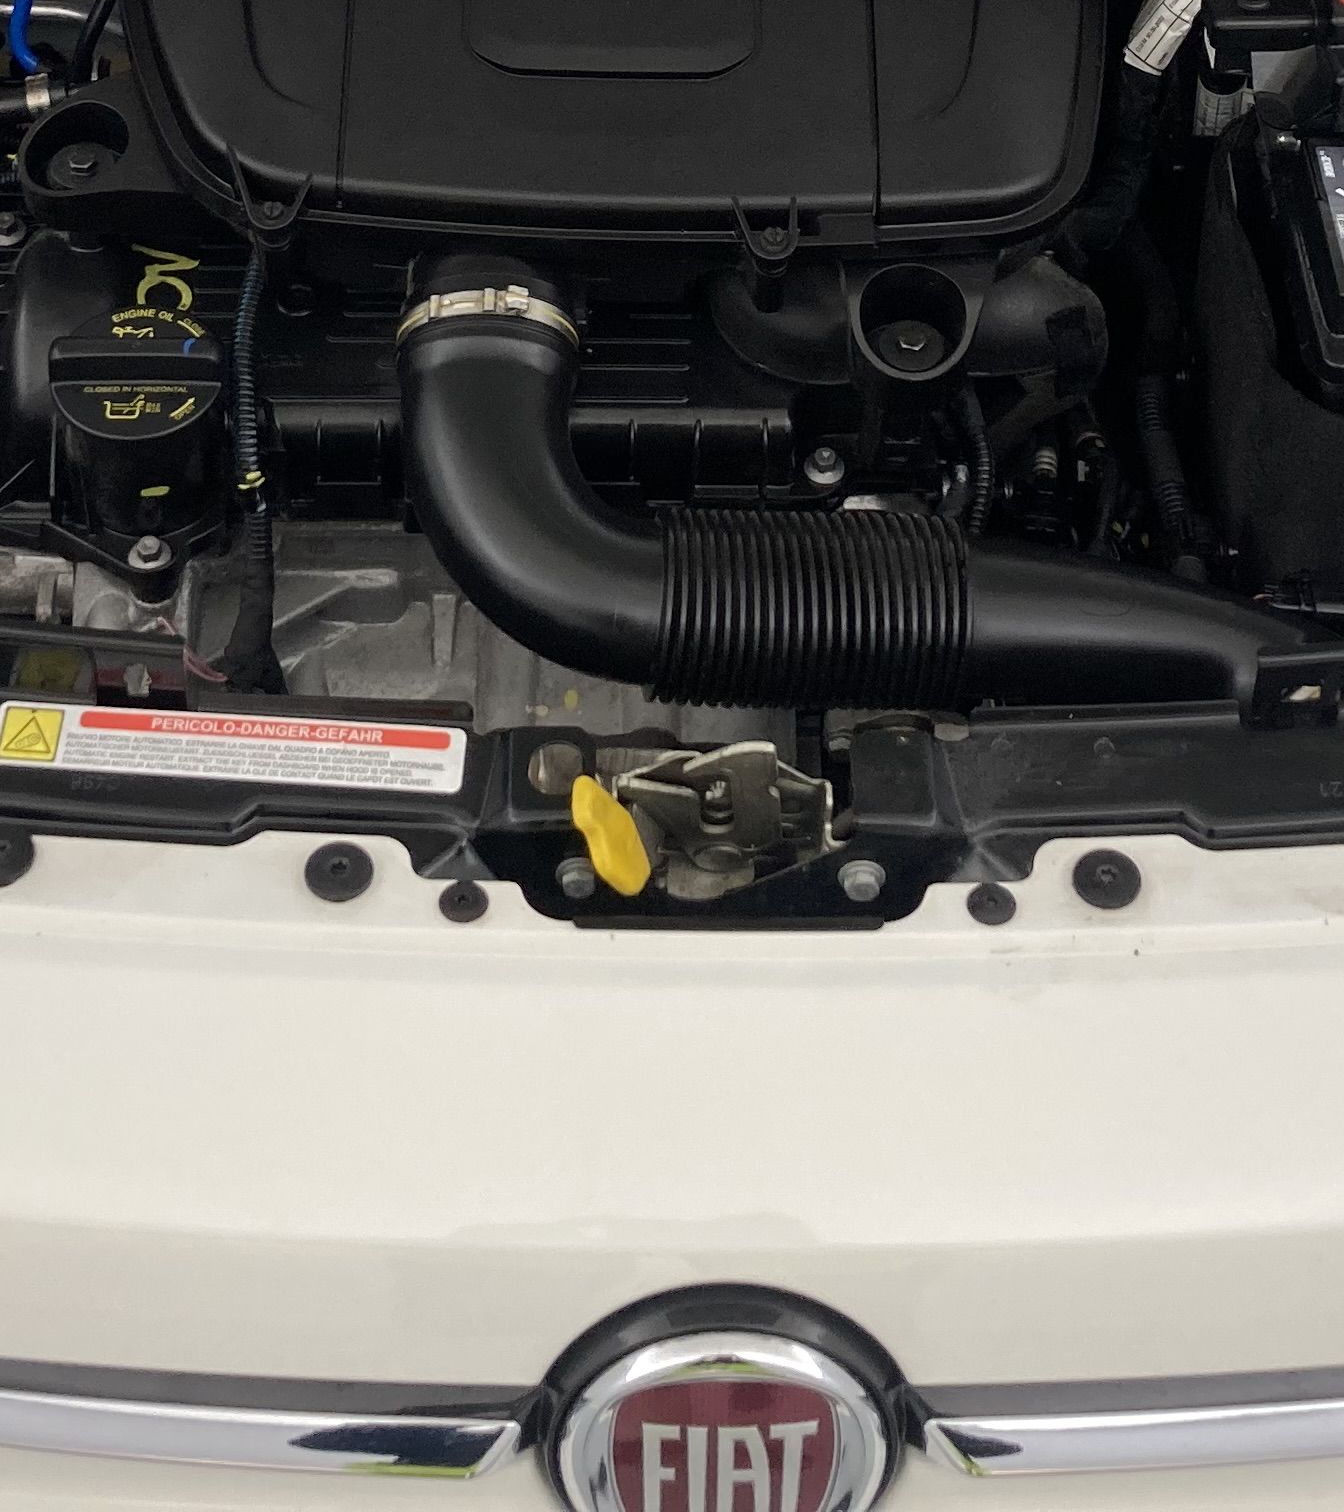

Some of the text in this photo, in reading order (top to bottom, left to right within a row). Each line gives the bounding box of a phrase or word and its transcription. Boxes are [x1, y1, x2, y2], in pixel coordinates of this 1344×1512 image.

[111, 308, 174, 323] ENGINE OIL
[150, 717, 384, 744] PERICOLO-DANGER-GEFAHR
[639, 1420, 821, 1512] FIAT
